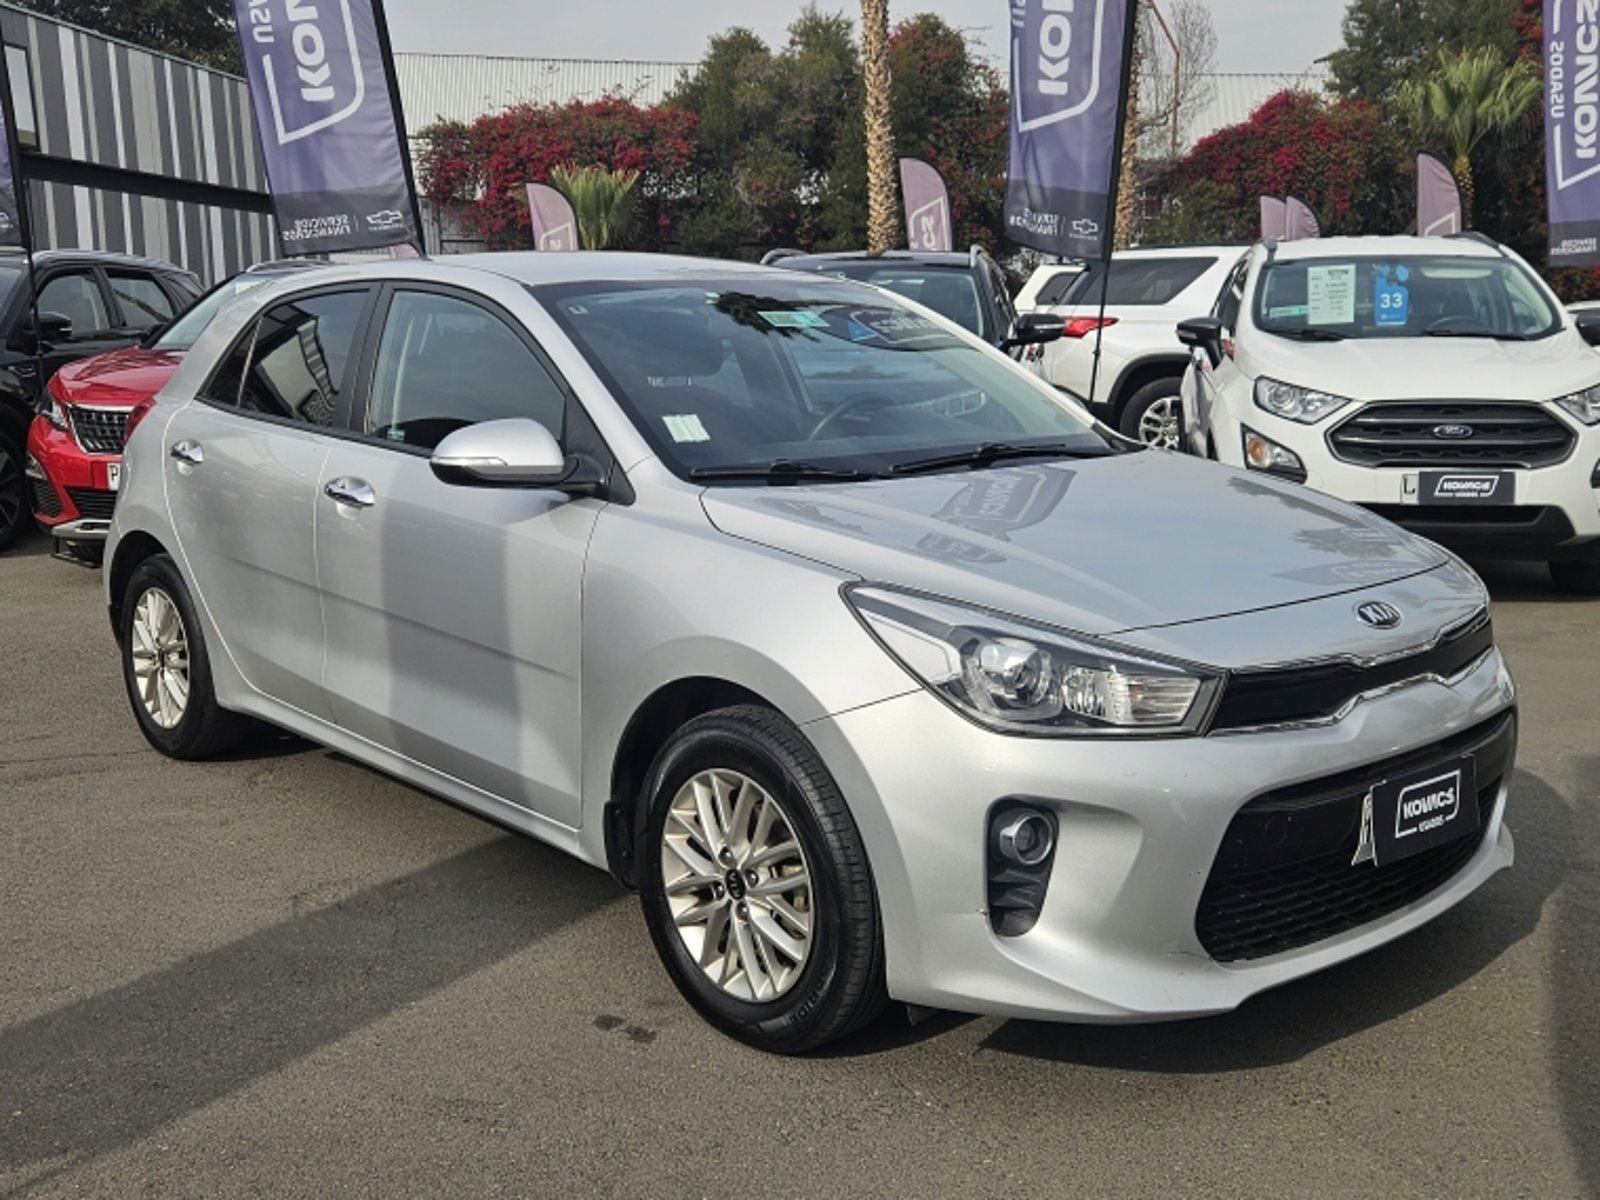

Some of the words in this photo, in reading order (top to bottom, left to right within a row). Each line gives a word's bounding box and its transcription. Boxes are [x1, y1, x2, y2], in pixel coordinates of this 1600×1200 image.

[1380, 292, 1403, 309] 33
[1359, 603, 1399, 623] KIA
[1402, 786, 1455, 819] KOVACS
